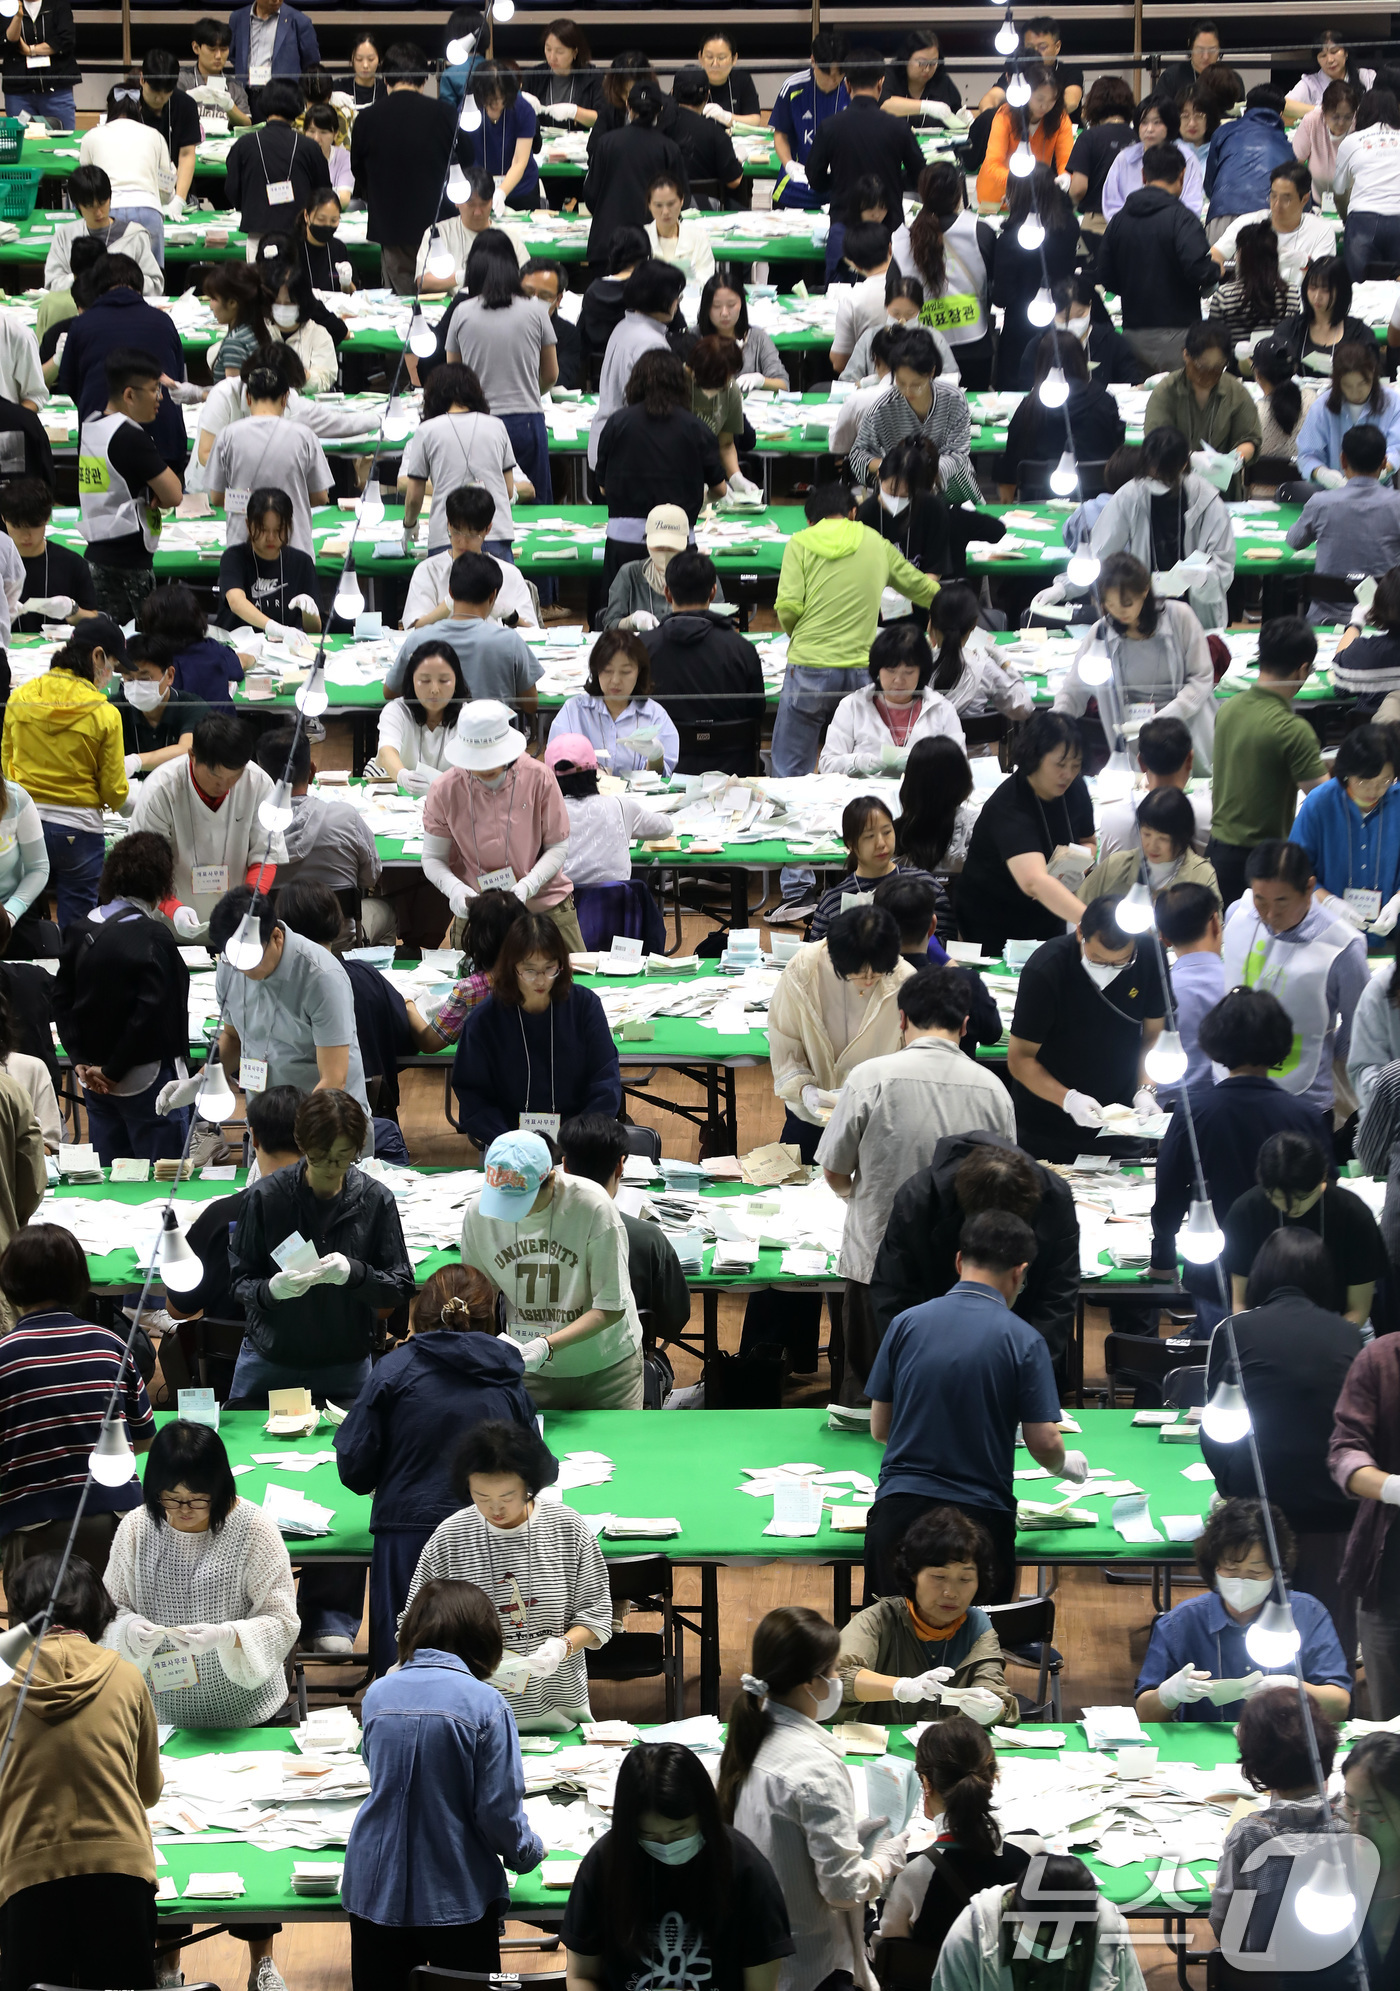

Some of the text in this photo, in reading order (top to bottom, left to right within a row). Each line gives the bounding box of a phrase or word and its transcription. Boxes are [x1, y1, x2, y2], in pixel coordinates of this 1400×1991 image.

[254, 577, 279, 592] NIKE
[197, 870, 225, 878] 개표사무원
[483, 872, 511, 886] 개표사무원
[524, 1118, 556, 1126] 개표사무원
[494, 1239, 579, 1270] UNIVERSITY
[515, 1263, 560, 1303] 77
[518, 1306, 584, 1324] ASHINGTON
[154, 1656, 188, 1669] 개표사무원
